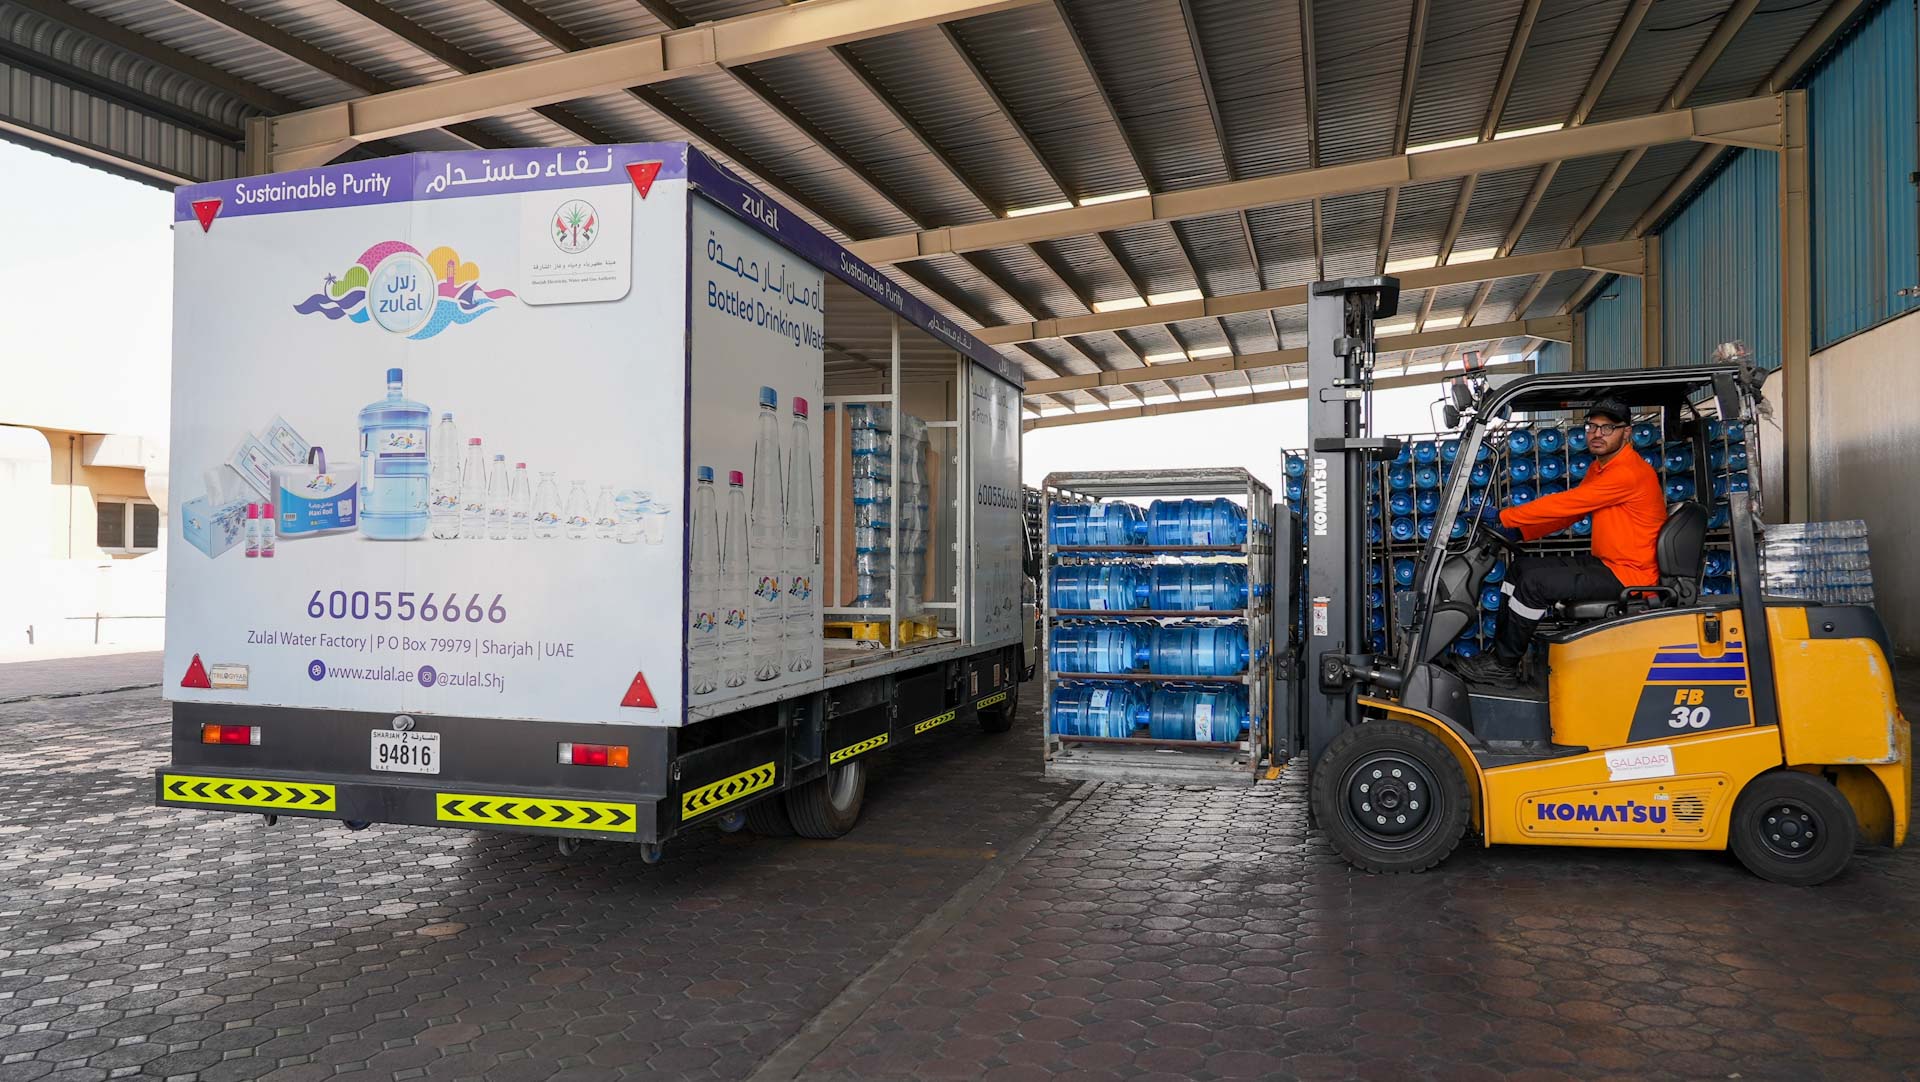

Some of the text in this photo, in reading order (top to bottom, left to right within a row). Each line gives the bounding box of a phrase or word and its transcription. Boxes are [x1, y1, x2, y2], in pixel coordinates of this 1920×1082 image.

[425, 148, 612, 193] نقاء مستدام
[235, 172, 391, 205] Sustainable Purity
[742, 192, 779, 231] zulal
[387, 275, 416, 293] زلال
[840, 252, 904, 311] Sustainable Purity
[379, 293, 423, 312] zulal
[708, 280, 754, 322] Bottled
[757, 301, 800, 347] Drinking
[1311, 458, 1328, 536] KOMATSU
[307, 590, 507, 624] 600556666
[247, 630, 277, 645] Zulal
[280, 632, 317, 646] Water
[320, 633, 367, 652] Factory
[377, 635, 385, 649] P
[388, 636, 399, 650] O
[402, 636, 426, 651] Box
[430, 638, 471, 653] 79979
[482, 639, 533, 659] Sharjah
[545, 643, 575, 658] UAE
[328, 666, 505, 693] www.zulal.ae @zulal.Shj
[1673, 689, 1705, 705] FB
[1668, 706, 1711, 728] 30
[373, 731, 408, 743] SHARJAH 2
[380, 743, 431, 766] 94816
[1610, 754, 1669, 769] GALADARI
[1537, 800, 1666, 823] KOMATSU
